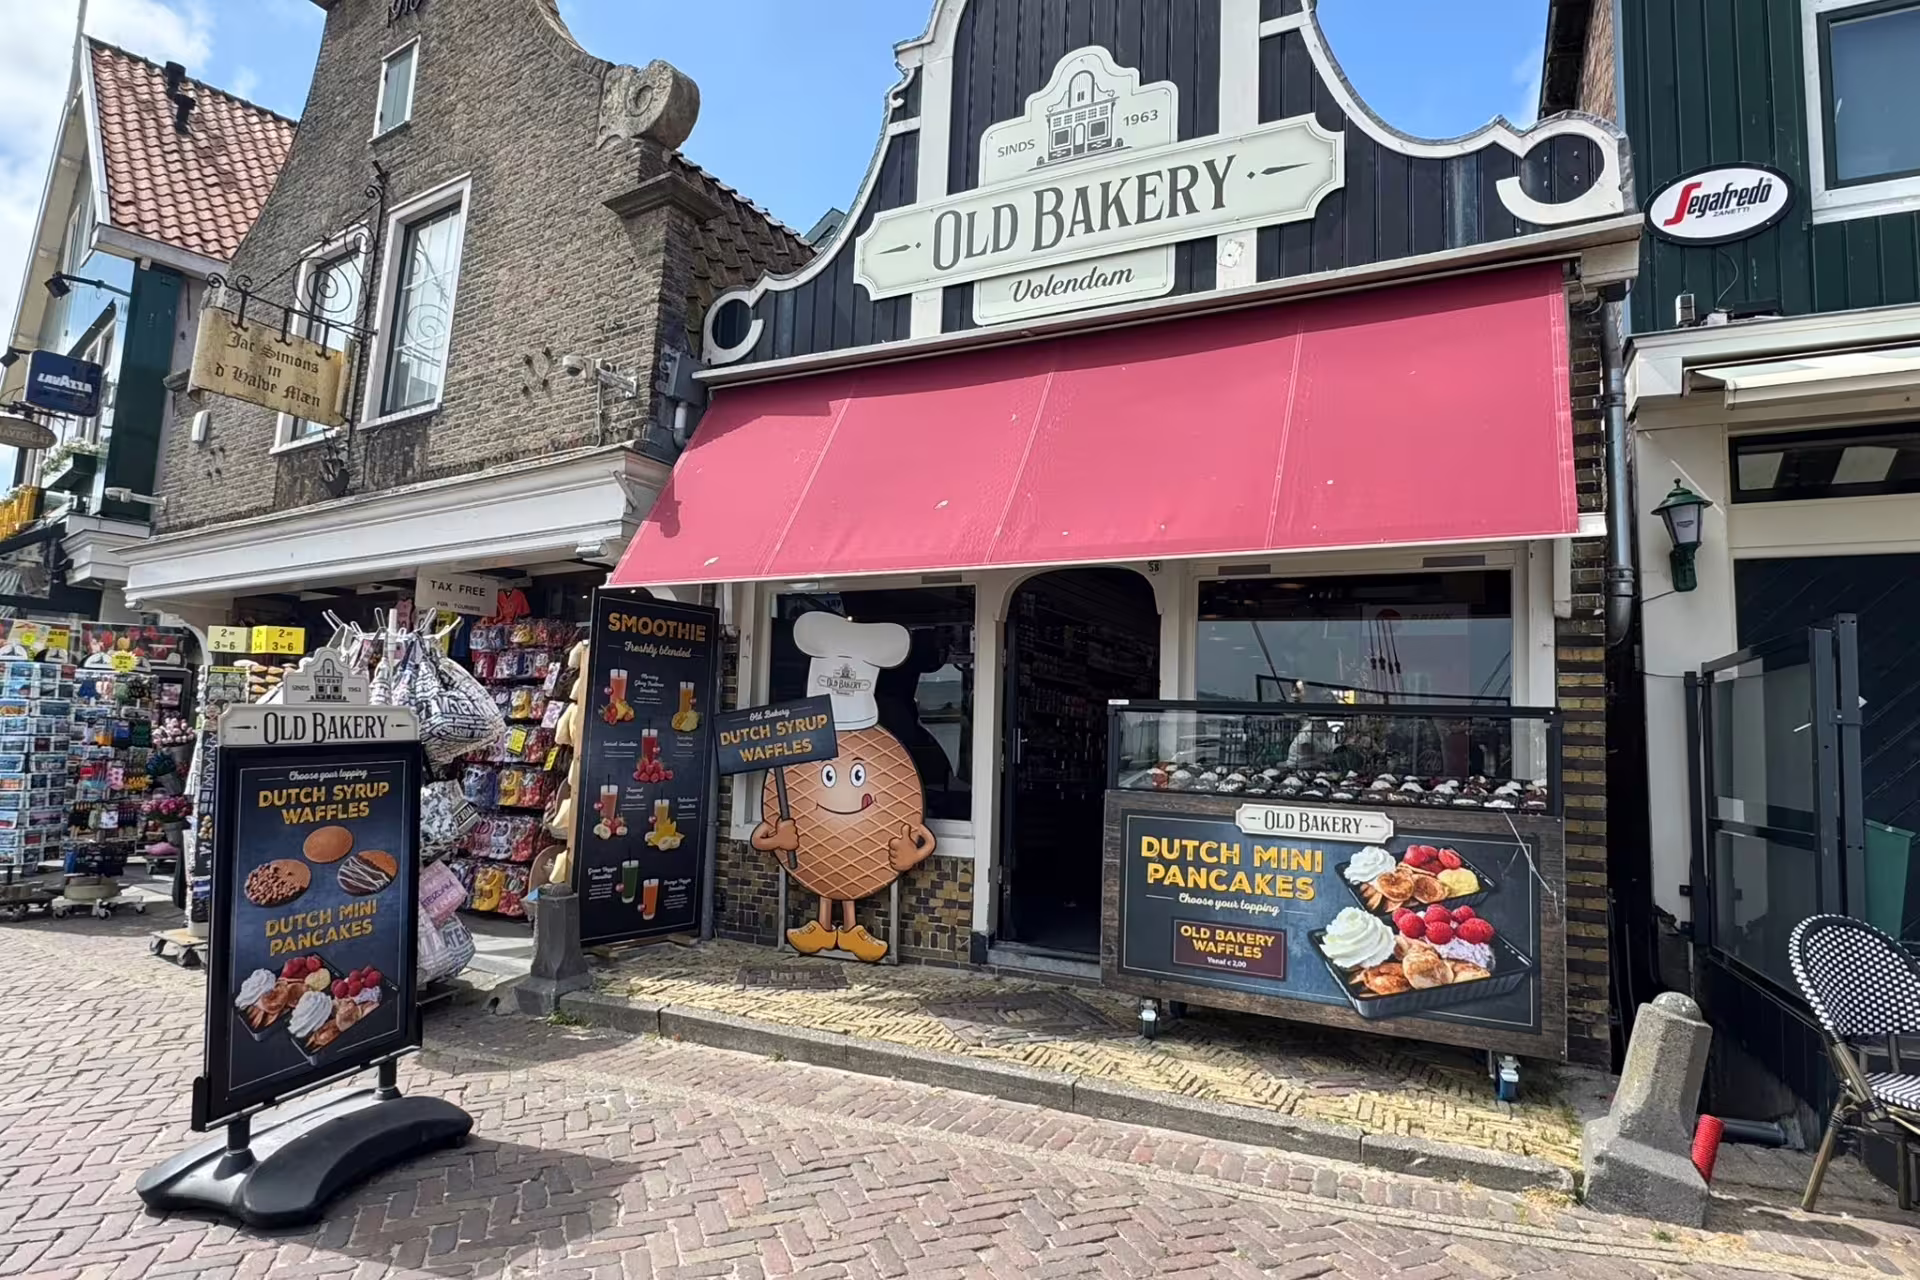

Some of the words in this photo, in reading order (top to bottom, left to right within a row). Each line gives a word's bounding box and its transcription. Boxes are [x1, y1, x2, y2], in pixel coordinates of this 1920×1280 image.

[1123, 109, 1159, 127] 1963
[997, 139, 1035, 158] SINDS
[932, 203, 1019, 271] OLD
[1031, 154, 1236, 252] BAKERY
[1663, 177, 1772, 226] Segafredo
[1712, 206, 1750, 217] ZANETTI
[1008, 265, 1135, 303] Volendam
[226, 331, 255, 352] Jac
[260, 344, 319, 374] Simons
[232, 365, 277, 395] Halve
[267, 365, 281, 378] in
[430, 580, 453, 592] TAX
[459, 584, 486, 597] FREE
[608, 612, 706, 642] SMOOTHIE
[214, 641, 220, 650] 3
[272, 642, 279, 651] 3
[624, 641, 658, 658] Freshly
[659, 645, 692, 658] blended
[839, 680, 861, 689] BAKERY
[749, 711, 763, 721] Old
[764, 708, 790, 719] Bakery
[263, 712, 306, 745] OLD
[312, 710, 389, 744] BAKERY
[720, 724, 770, 746] DUTCH
[776, 714, 828, 736] SYRUP
[739, 738, 813, 762] WAFFLES
[289, 770, 319, 781] Choose
[320, 771, 338, 782] your
[339, 768, 368, 780] topping
[258, 786, 326, 808] DUTCH
[333, 782, 390, 801] SYRUP
[281, 801, 370, 825] WAFFLES
[1264, 809, 1295, 831] OLD
[1299, 811, 1363, 835] BAKERY
[1141, 835, 1241, 866] DUTCH
[1254, 844, 1324, 873] MINI
[1146, 862, 1316, 901] PANCAKES
[1179, 892, 1213, 906] Choose
[1214, 899, 1239, 910] your
[1240, 899, 1280, 916] topping
[265, 908, 332, 937] DUTCH
[338, 898, 377, 920] MINI
[269, 918, 373, 957] PANCAKES
[1180, 925, 1210, 939] OLD
[1215, 929, 1275, 947] BAKERY
[1192, 939, 1262, 959] WAFFLES
[1207, 956, 1226, 966] Vanaf
